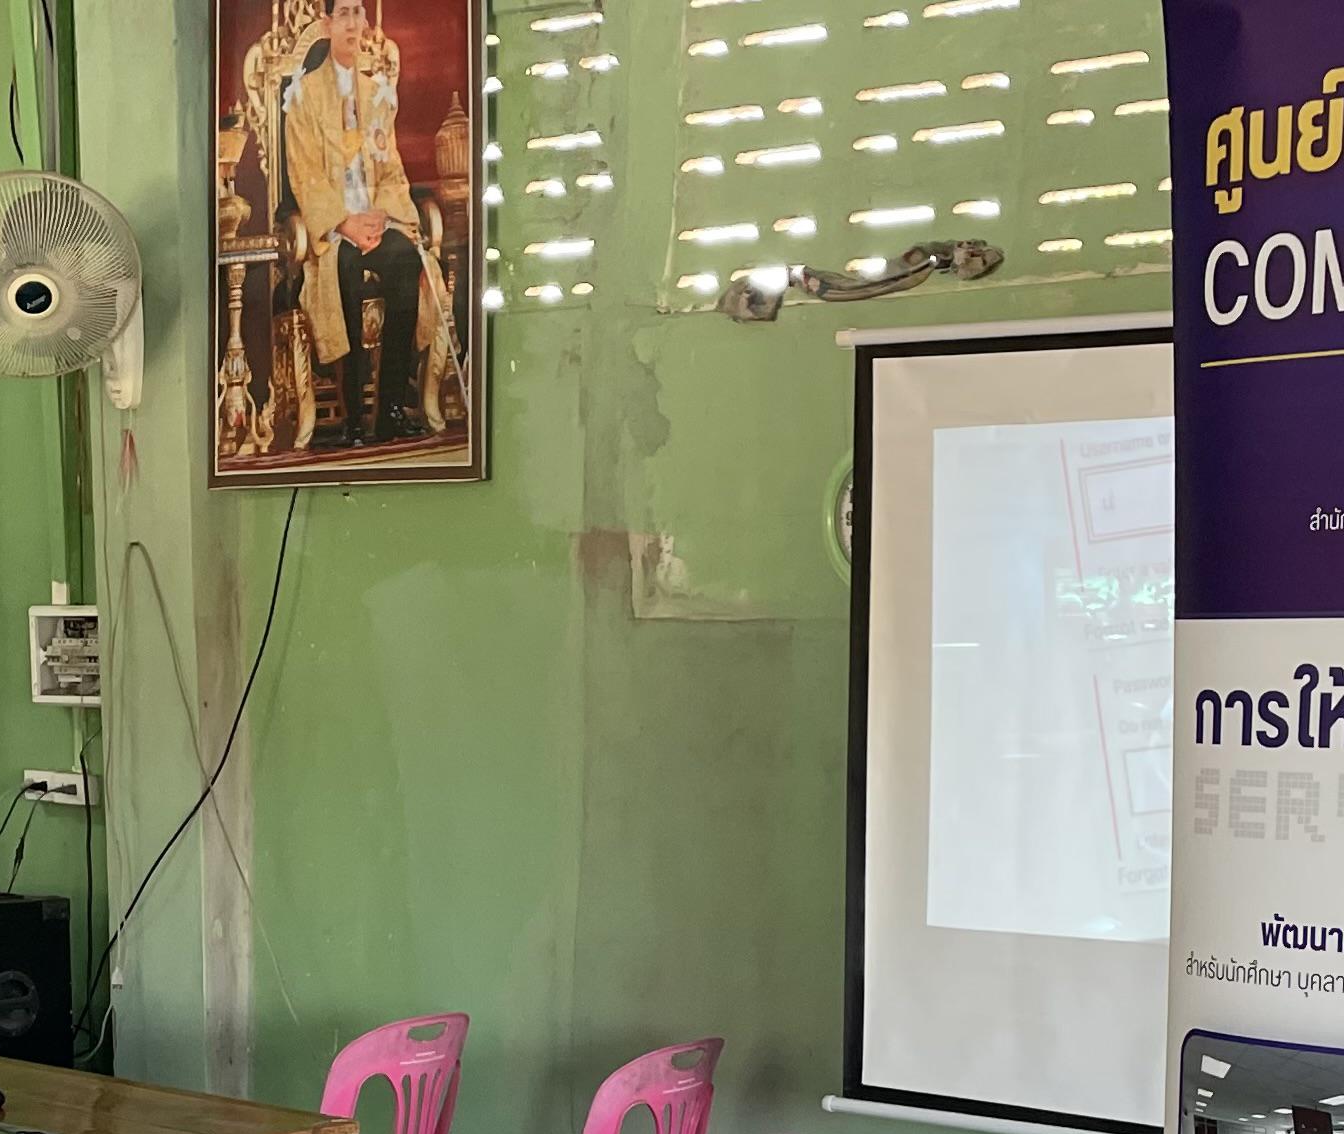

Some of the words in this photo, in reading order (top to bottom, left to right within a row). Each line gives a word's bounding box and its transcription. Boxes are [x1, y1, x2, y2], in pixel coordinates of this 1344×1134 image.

[1186, 951, 1291, 988] สำหรับนักศึกษา
